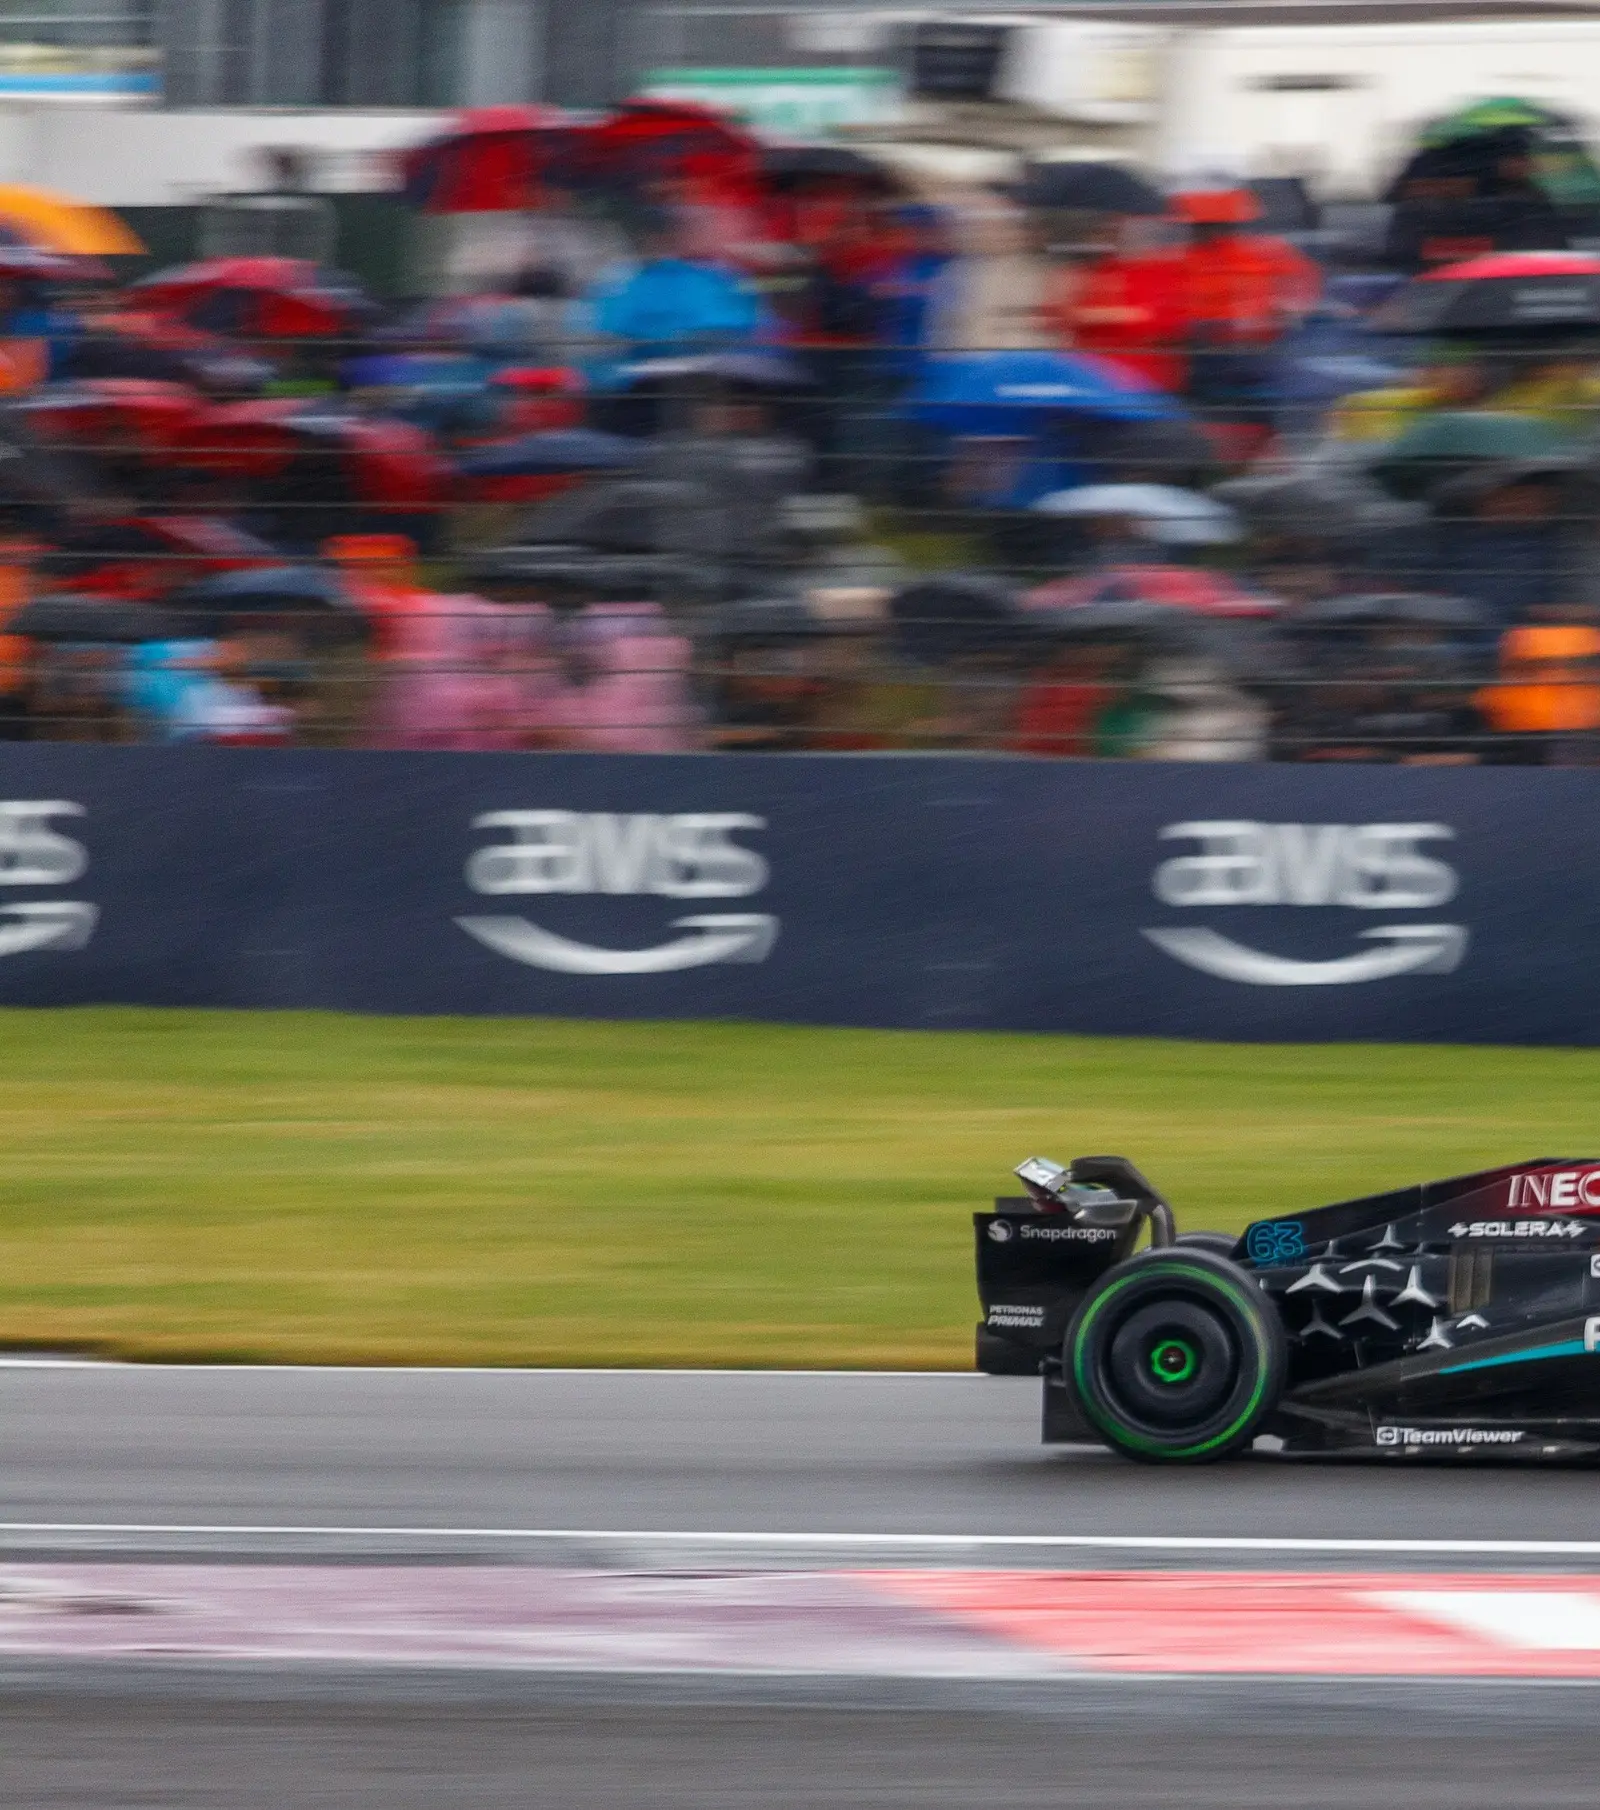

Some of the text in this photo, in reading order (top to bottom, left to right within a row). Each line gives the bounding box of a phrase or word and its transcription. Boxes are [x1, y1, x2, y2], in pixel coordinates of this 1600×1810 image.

[465, 809, 768, 898] aws
[1154, 820, 1458, 909] aws
[1020, 1225, 1117, 1243] Snapdragon
[1468, 1221, 1564, 1237] SOLERA
[1247, 1220, 1304, 1262] 63
[988, 1305, 1044, 1315] PETRONAS
[987, 1316, 1044, 1328] PRIMAX
[1400, 1428, 1525, 1444] TeamViewer
